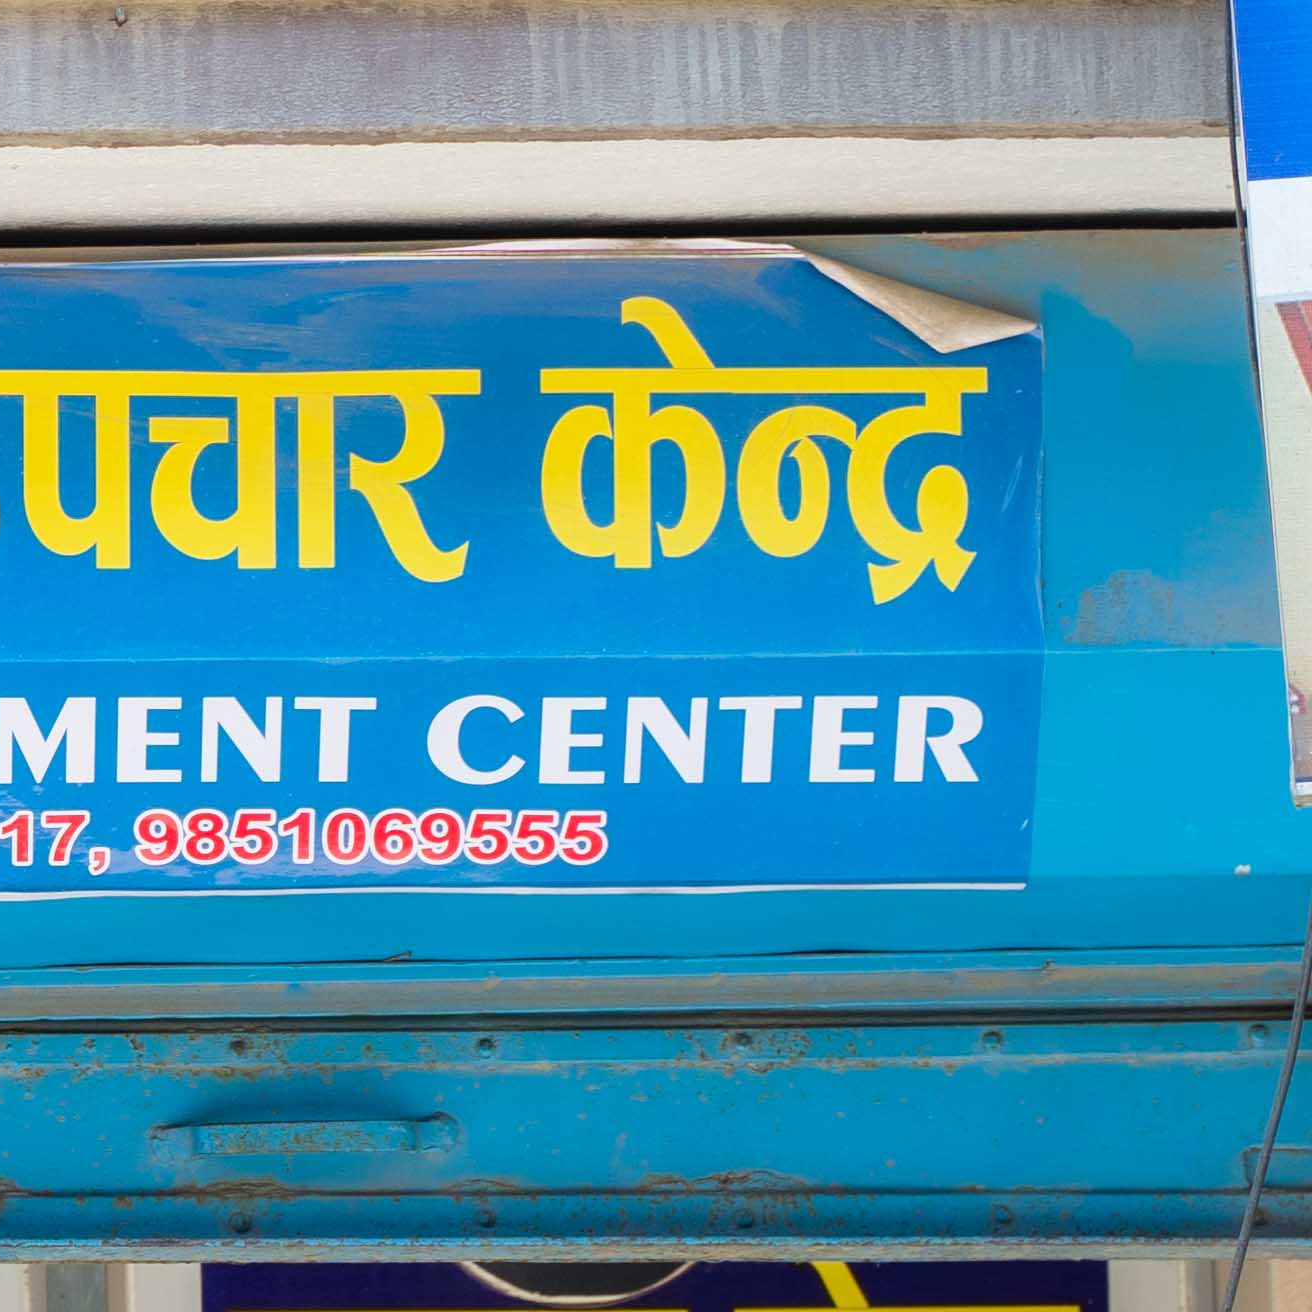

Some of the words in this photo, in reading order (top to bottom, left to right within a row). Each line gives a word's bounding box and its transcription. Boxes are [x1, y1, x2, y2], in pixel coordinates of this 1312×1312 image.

[540, 296, 987, 605] केन्द्र
[423, 690, 983, 788] CENTER
[132, 806, 611, 870] 9851069555
